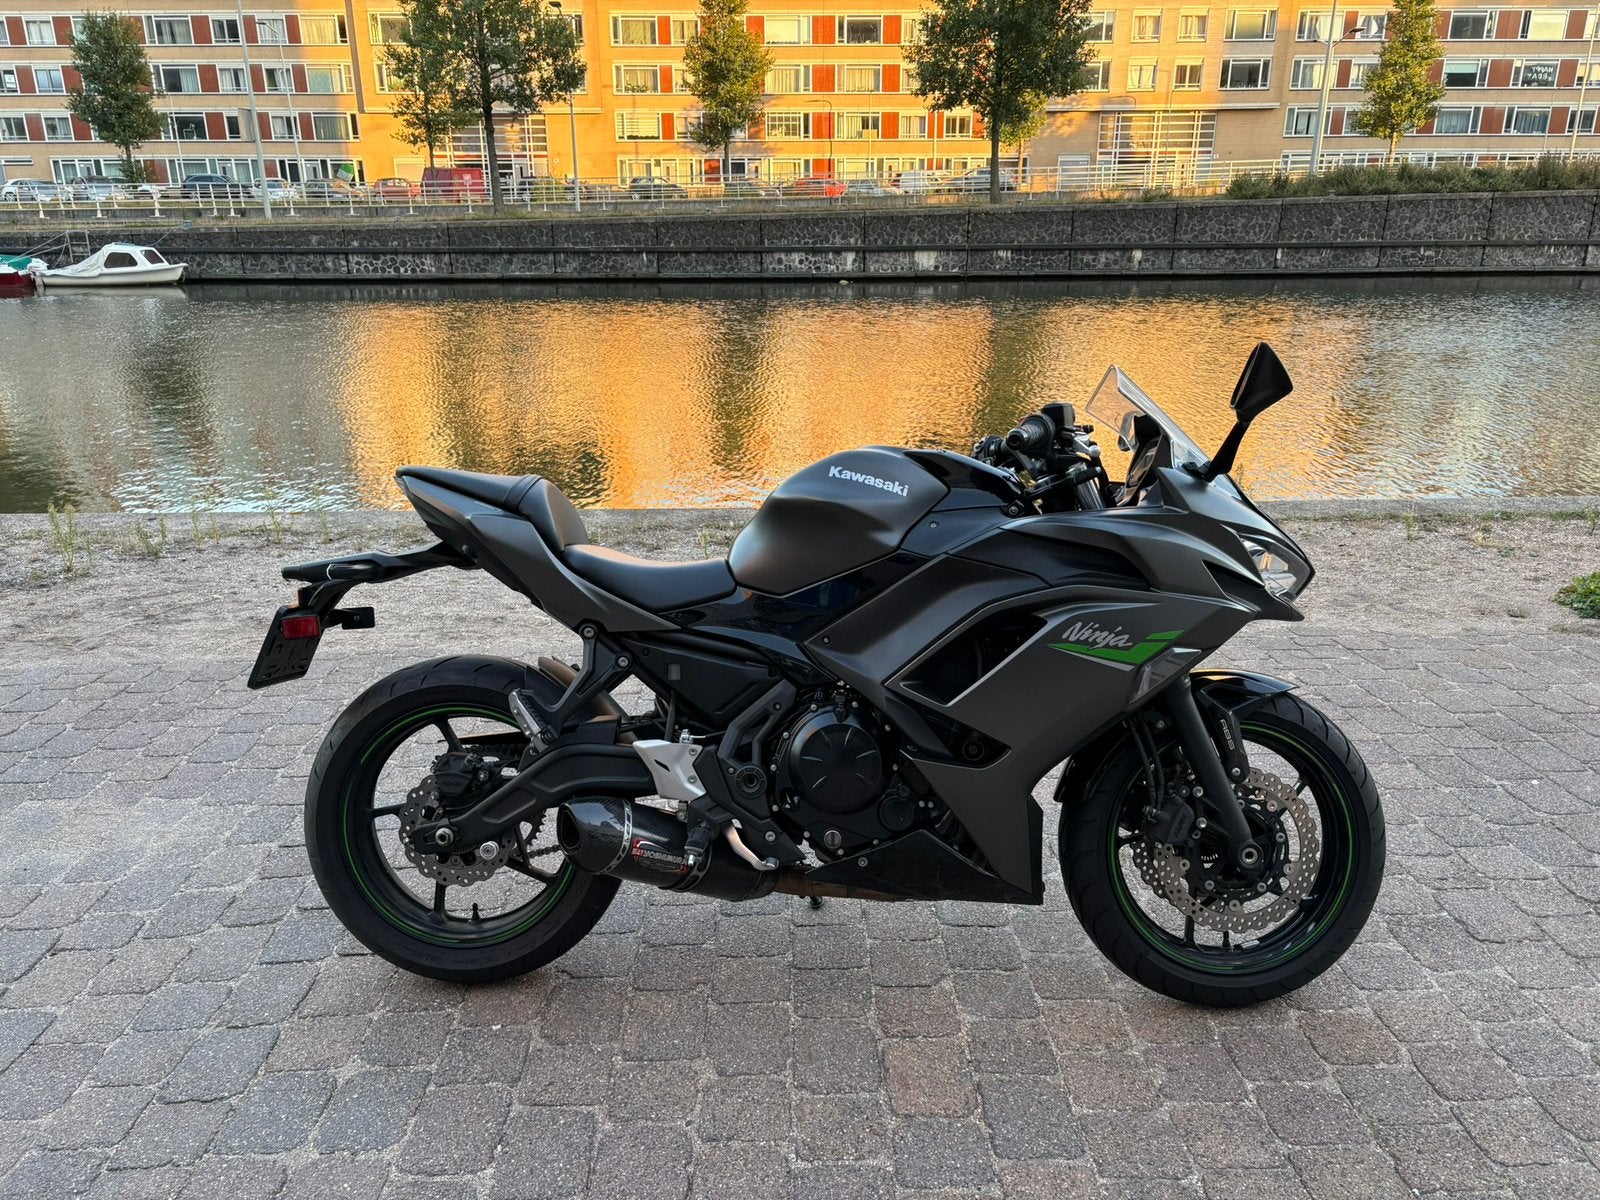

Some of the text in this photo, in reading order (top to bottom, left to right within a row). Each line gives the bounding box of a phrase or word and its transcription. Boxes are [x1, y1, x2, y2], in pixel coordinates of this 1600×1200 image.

[828, 466, 909, 497] Kawasaki
[1061, 621, 1133, 650] Ninja
[1220, 718, 1235, 751] ABS
